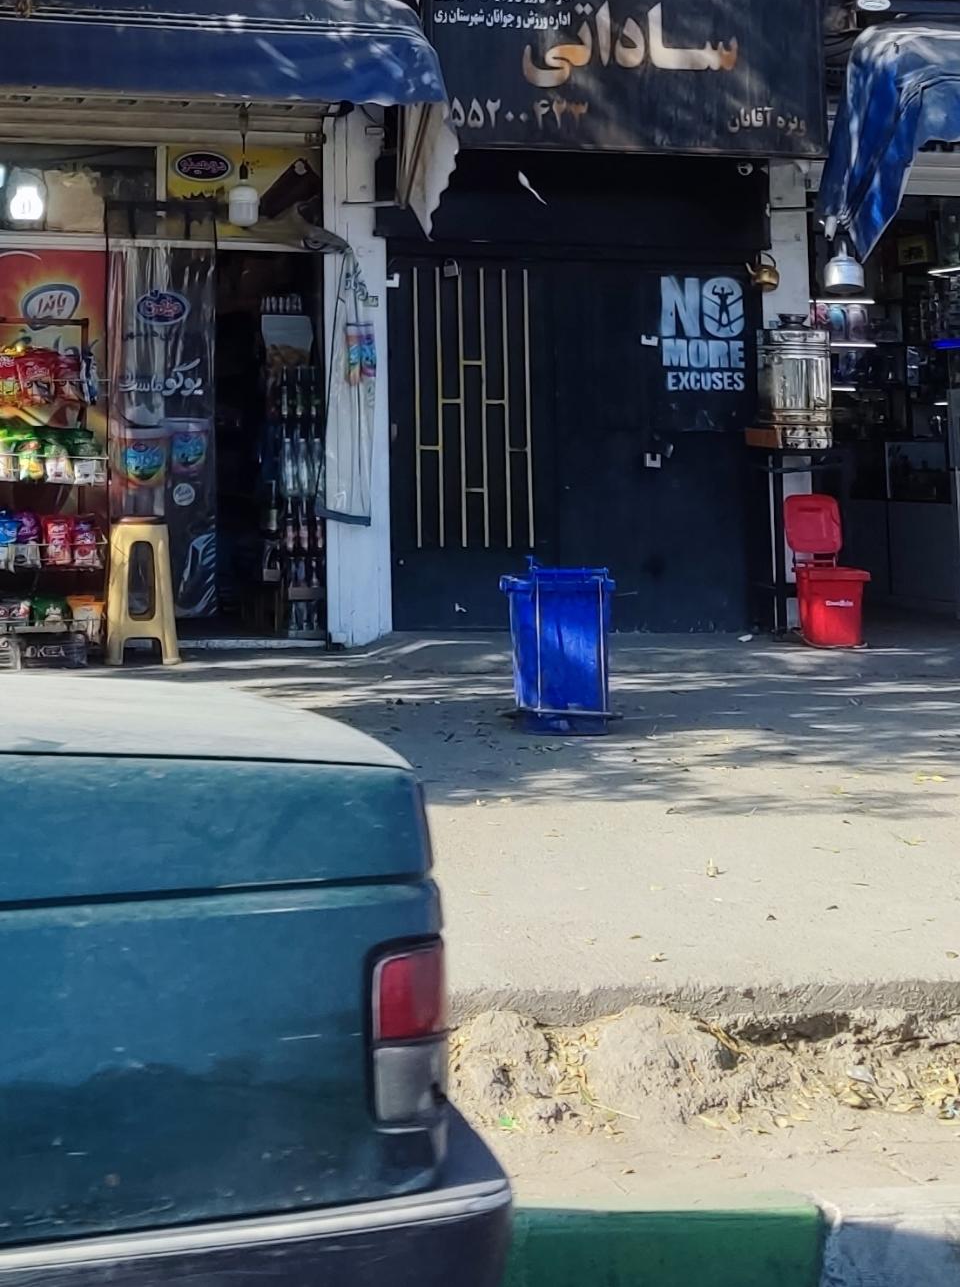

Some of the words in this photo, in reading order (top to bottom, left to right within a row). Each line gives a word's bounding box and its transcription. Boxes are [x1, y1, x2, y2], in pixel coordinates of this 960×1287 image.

[434, 10, 448, 24] ری
[448, 7, 486, 27] شهرستان
[486, 8, 515, 28] جوانان
[522, 10, 548, 30] ورزش
[549, 11, 571, 30] اداره
[522, 1, 738, 88] ساداتی
[660, 275, 745, 338] NO
[662, 337, 746, 369] MORE
[667, 371, 745, 391] EXCUSES
